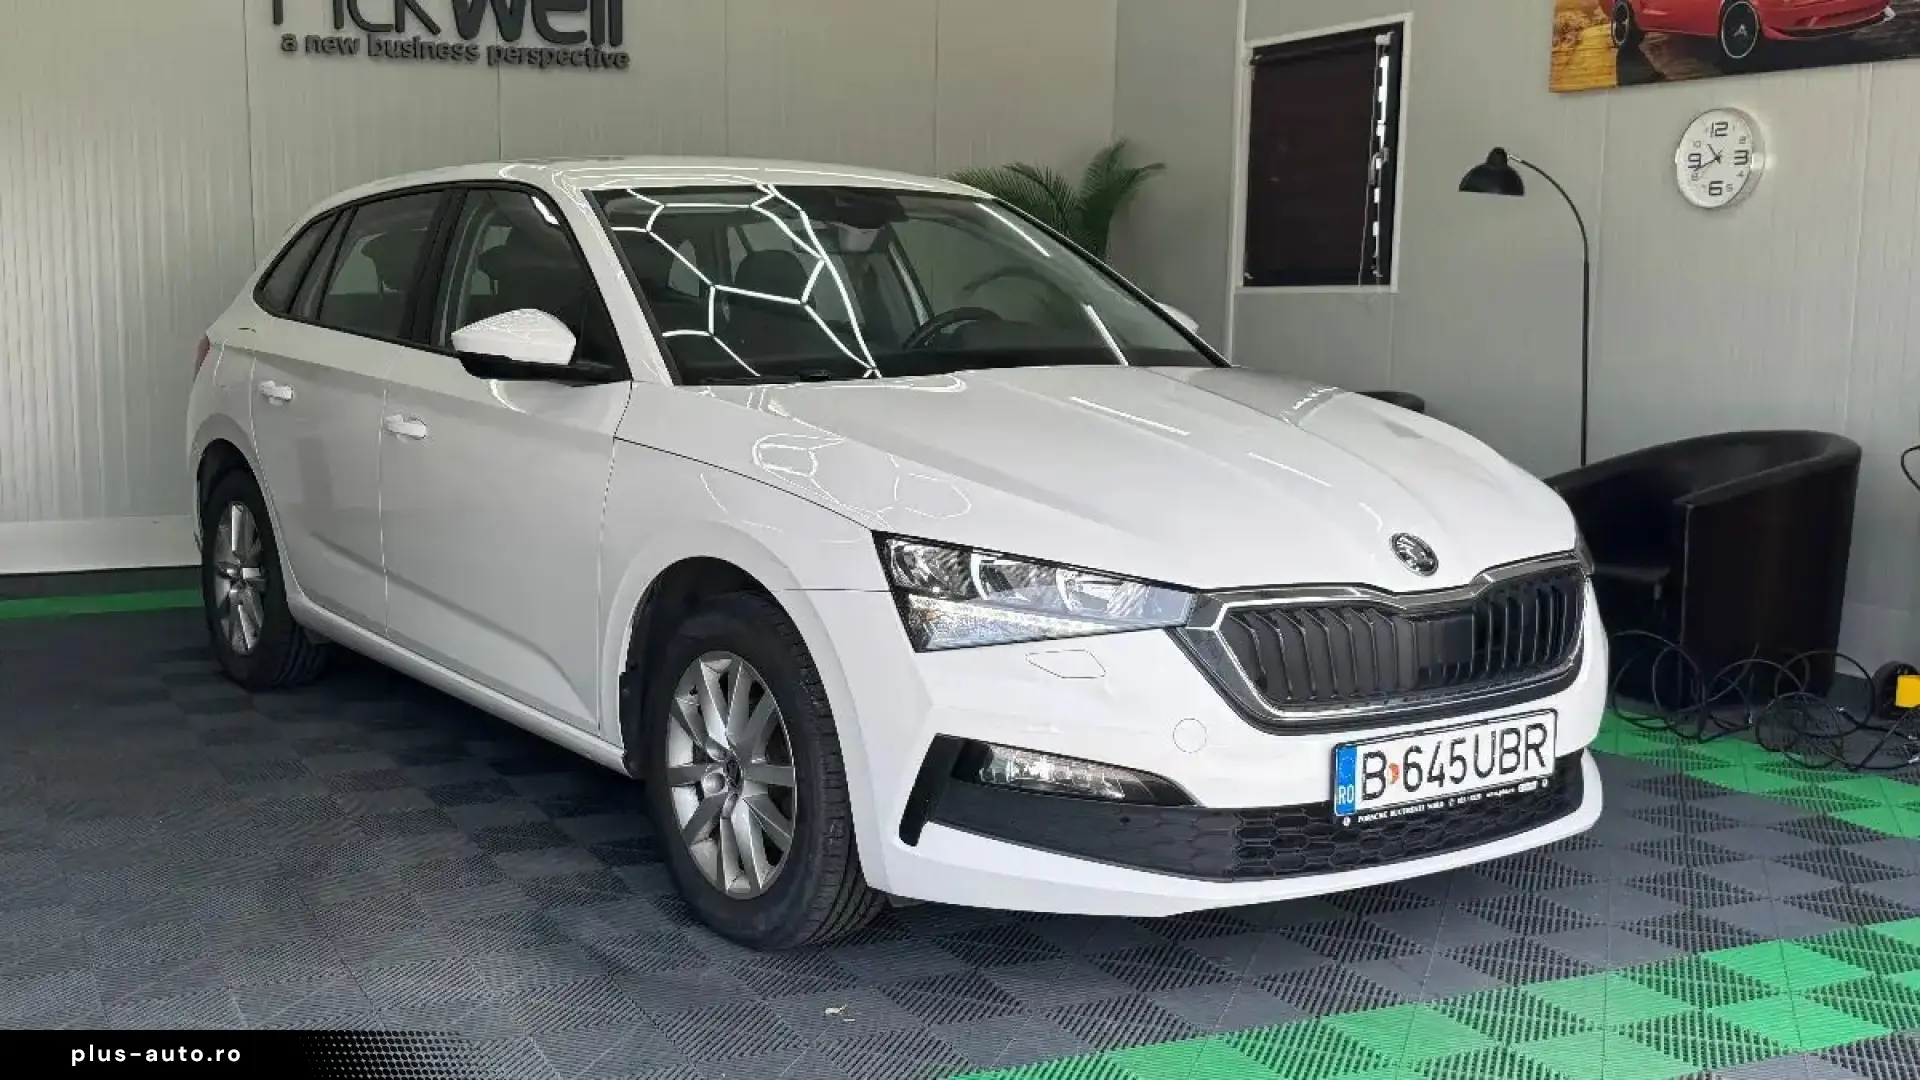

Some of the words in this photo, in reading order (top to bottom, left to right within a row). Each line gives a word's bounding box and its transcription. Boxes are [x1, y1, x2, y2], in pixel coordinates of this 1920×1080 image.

[281, 33, 298, 51] a
[305, 34, 360, 56] new
[367, 33, 480, 62] business
[486, 44, 631, 69] perspective
[1710, 121, 1728, 138] 12
[1687, 153, 1702, 169] 9
[1733, 149, 1750, 166] 3
[1708, 180, 1724, 196] 6
[1338, 784, 1355, 805] RO
